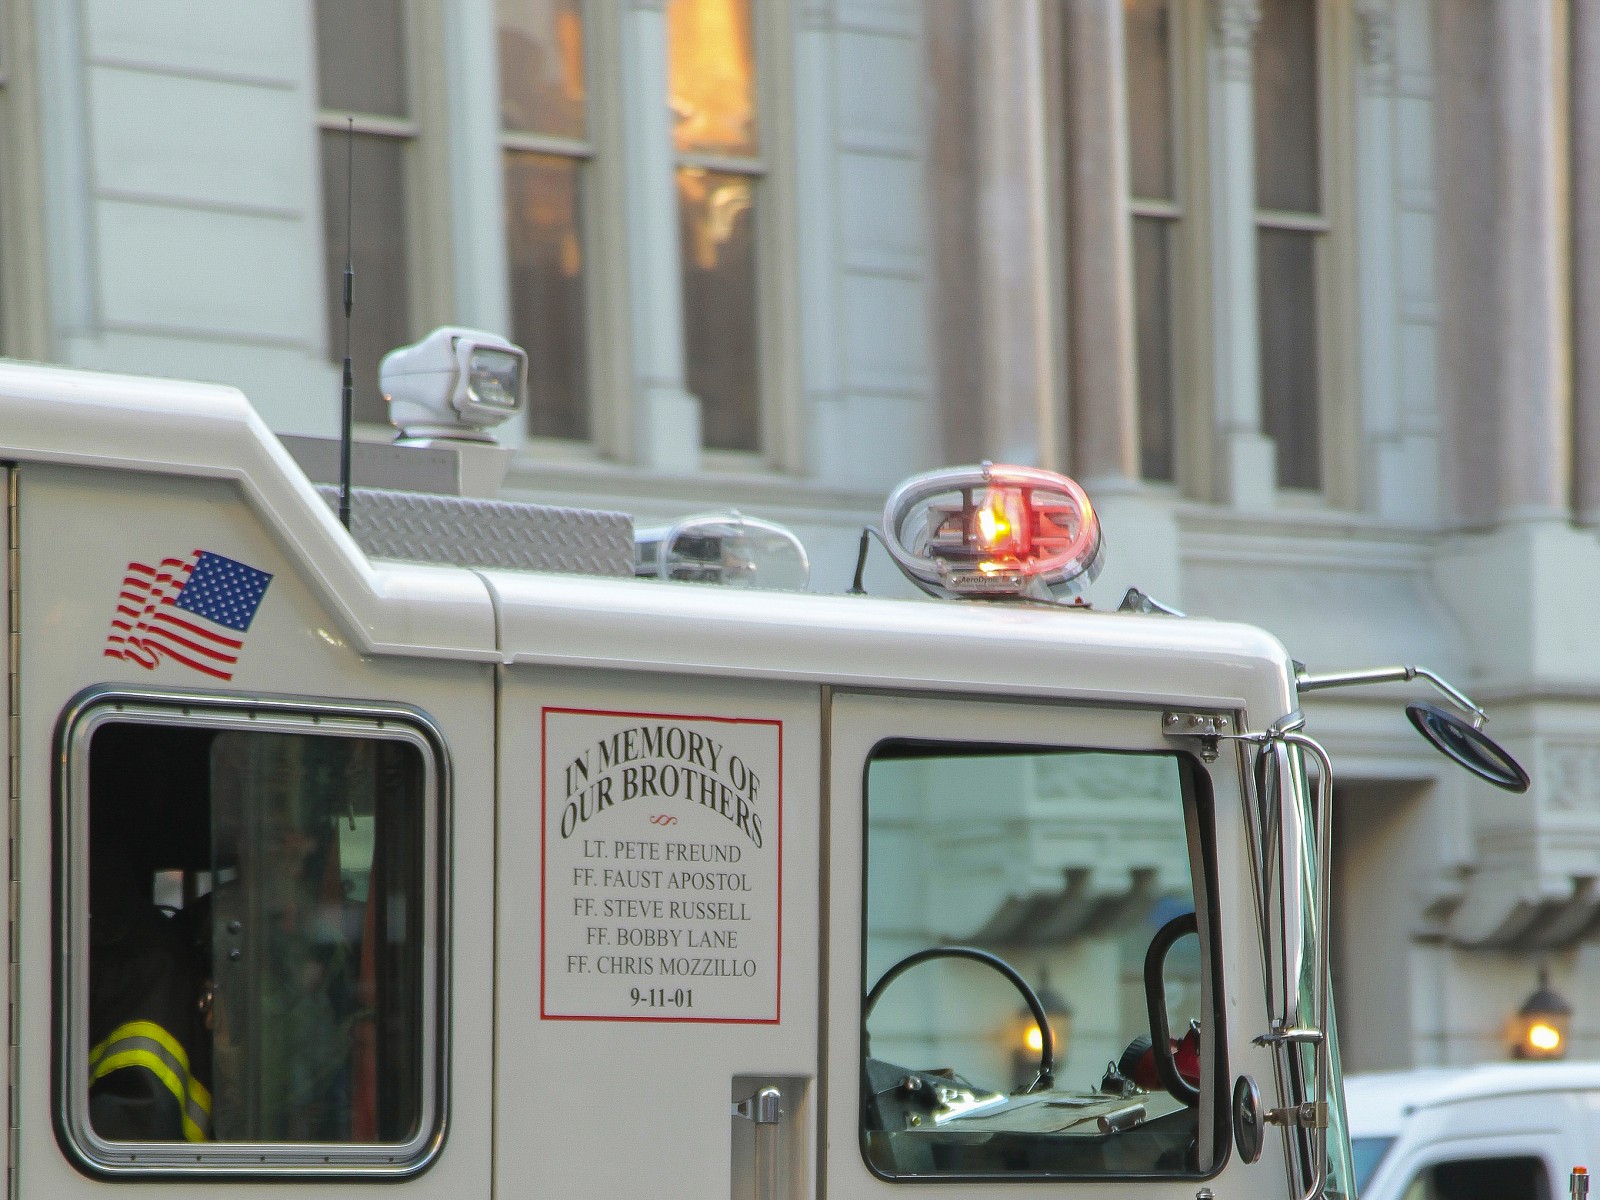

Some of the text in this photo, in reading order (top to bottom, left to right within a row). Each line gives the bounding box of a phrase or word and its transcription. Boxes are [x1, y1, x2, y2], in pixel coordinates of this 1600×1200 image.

[565, 726, 760, 804] IN MEMORY OF
[560, 764, 763, 849] OUR BROTHERS
[583, 839, 742, 863] LT. PETE FREUND
[572, 868, 752, 892] FF. FAUST APOSTOL
[573, 898, 751, 921] FF. STEVE RUSSELL
[586, 927, 738, 949] FF. BOBBY LANE
[566, 955, 757, 978] FF. CHRIS MOZZILLO
[630, 988, 694, 1008] 9-11-01
